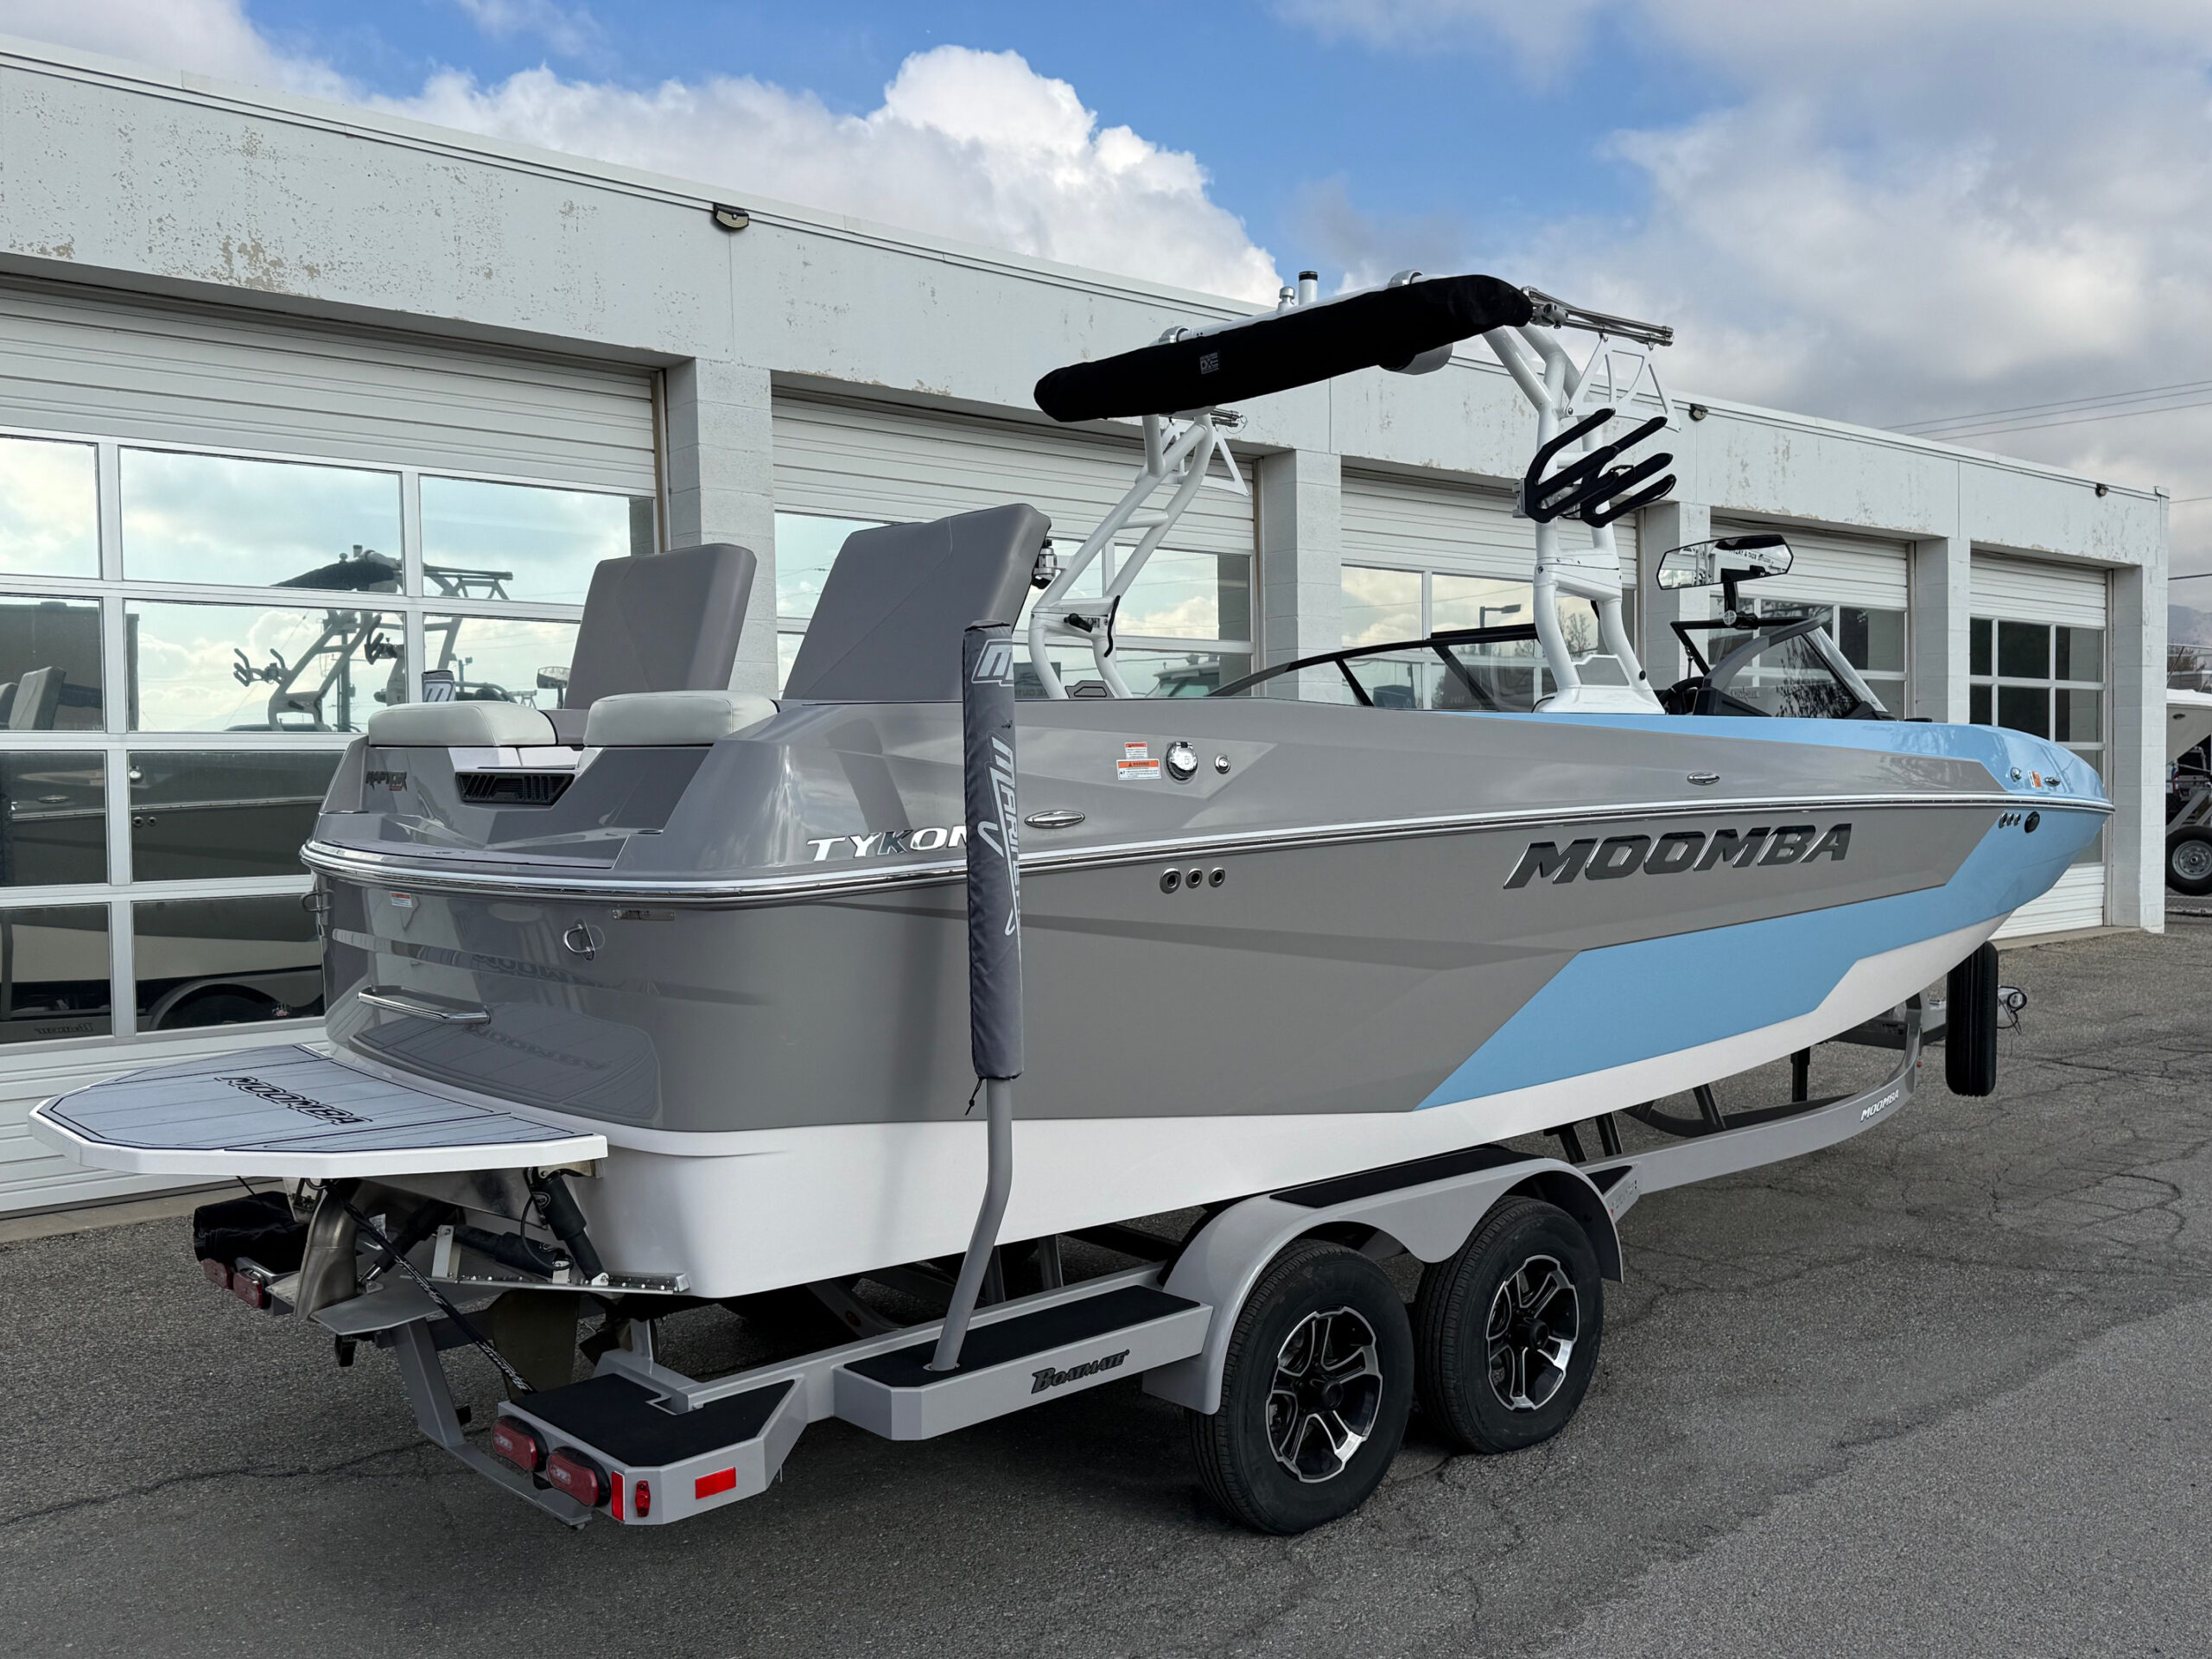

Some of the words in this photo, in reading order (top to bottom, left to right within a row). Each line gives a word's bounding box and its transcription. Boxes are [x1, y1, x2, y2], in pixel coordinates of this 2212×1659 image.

[1503, 823, 1852, 890] MOOMBA
[215, 1077, 372, 1125] MOOMBA
[1859, 1089, 1899, 1122] MOOMBA
[1031, 1351, 1127, 1394] BOATMATE
